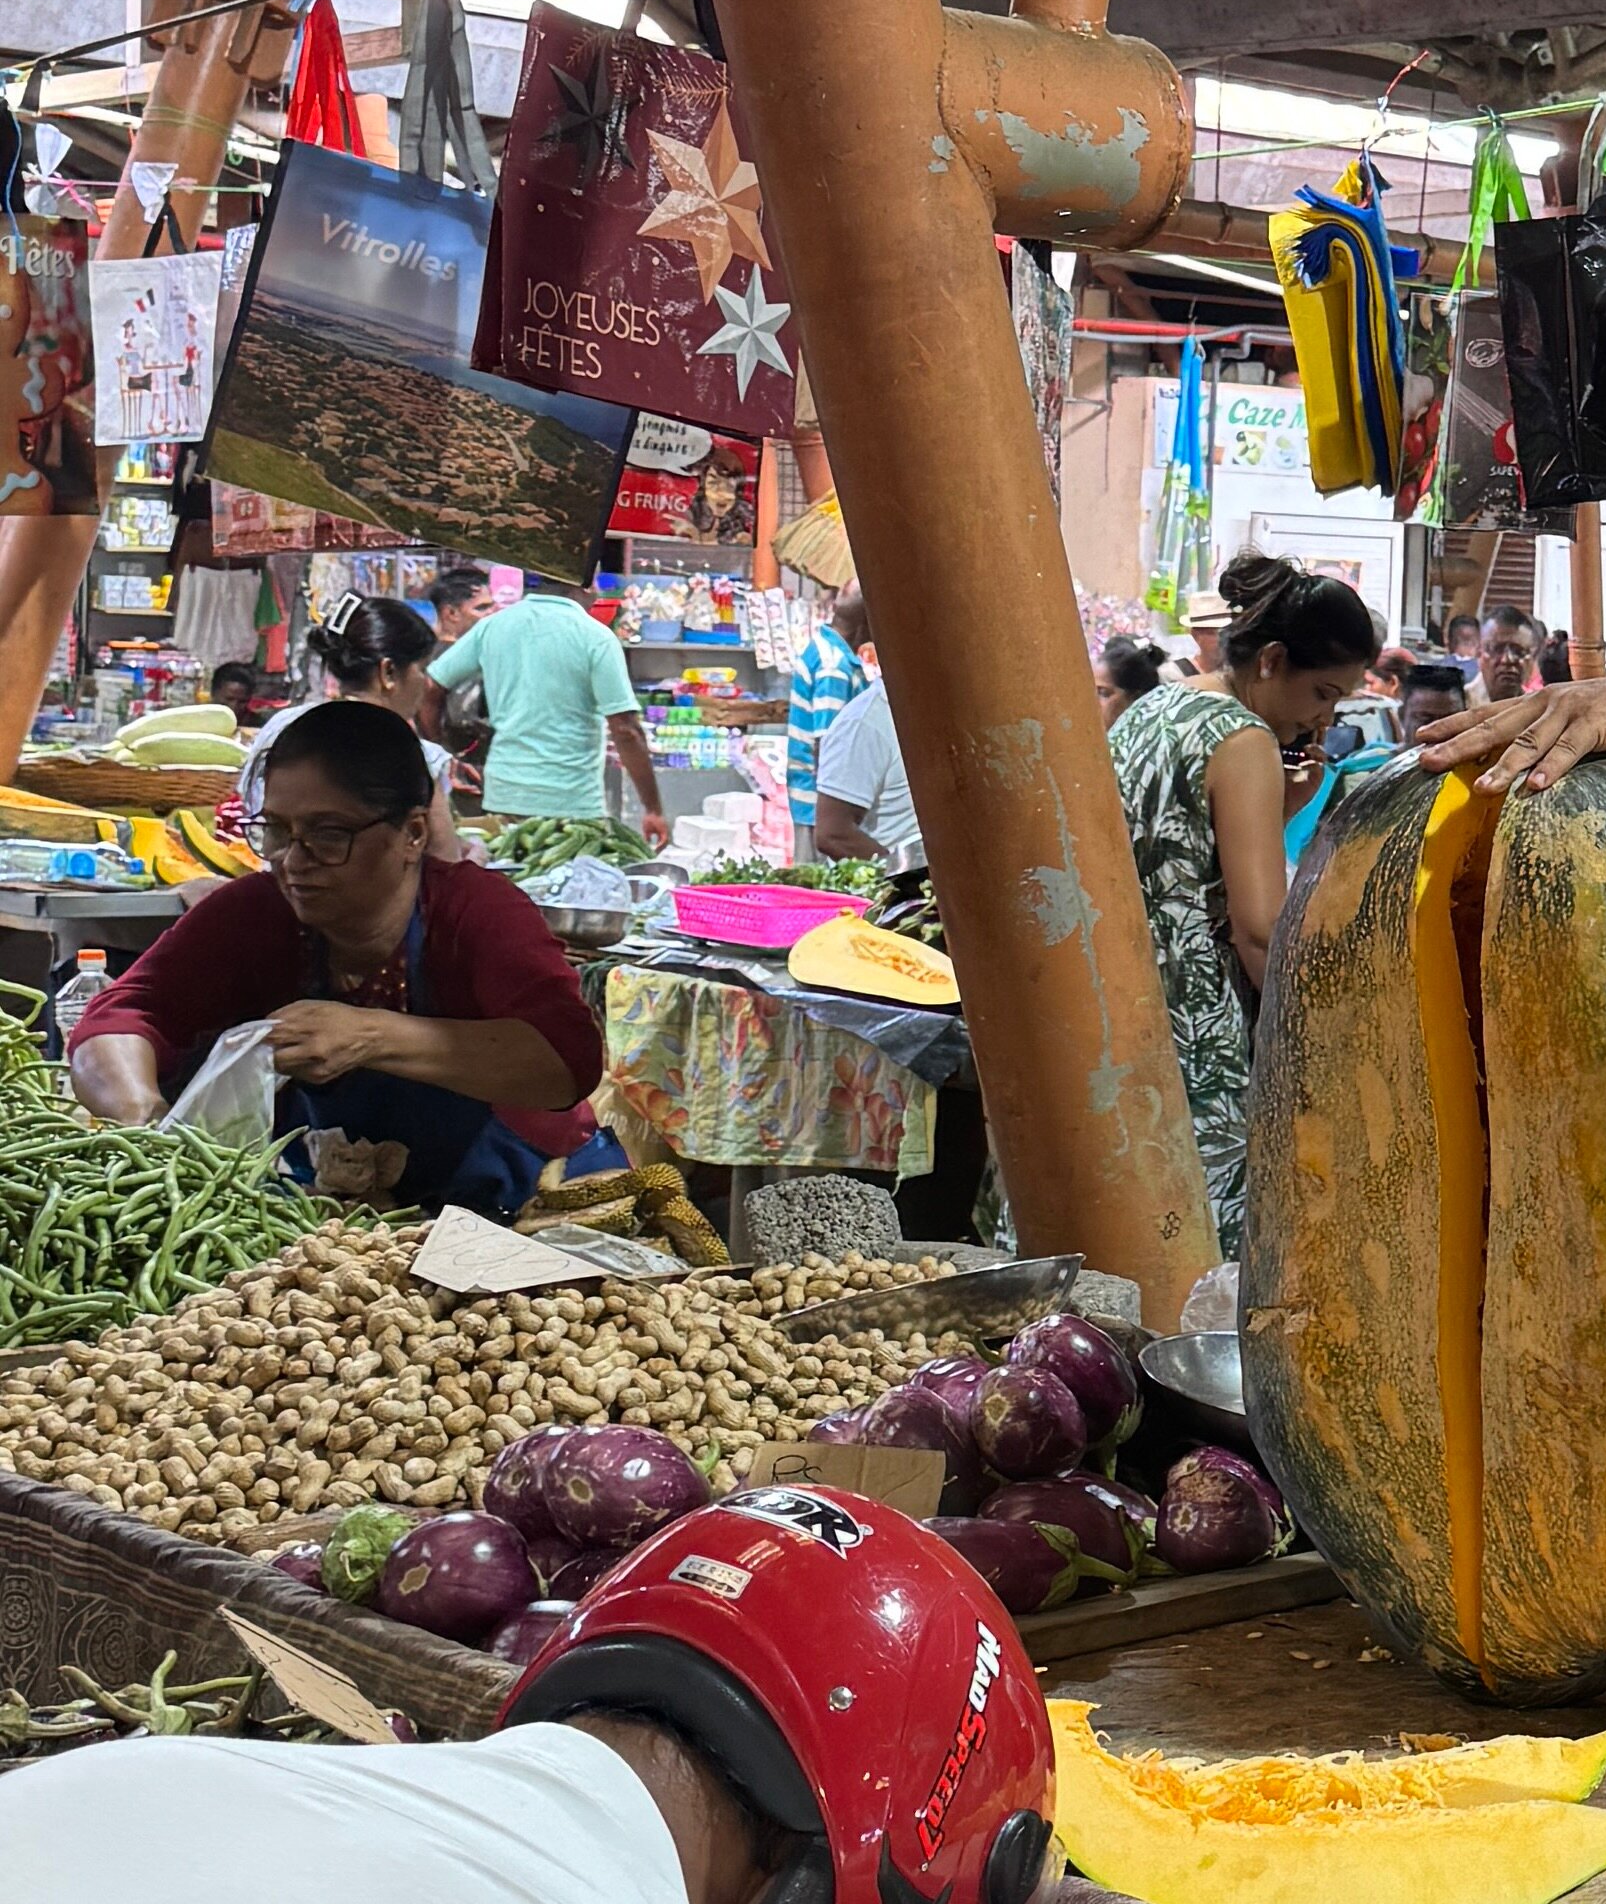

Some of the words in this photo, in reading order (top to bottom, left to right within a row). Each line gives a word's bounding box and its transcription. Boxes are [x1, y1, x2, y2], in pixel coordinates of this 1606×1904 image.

[0, 234, 75, 280] Fêtes
[322, 212, 458, 282] Vitrolles
[523, 277, 661, 347] JOYEUSES
[519, 323, 603, 379] FÊTES
[1228, 397, 1287, 428] Caze
